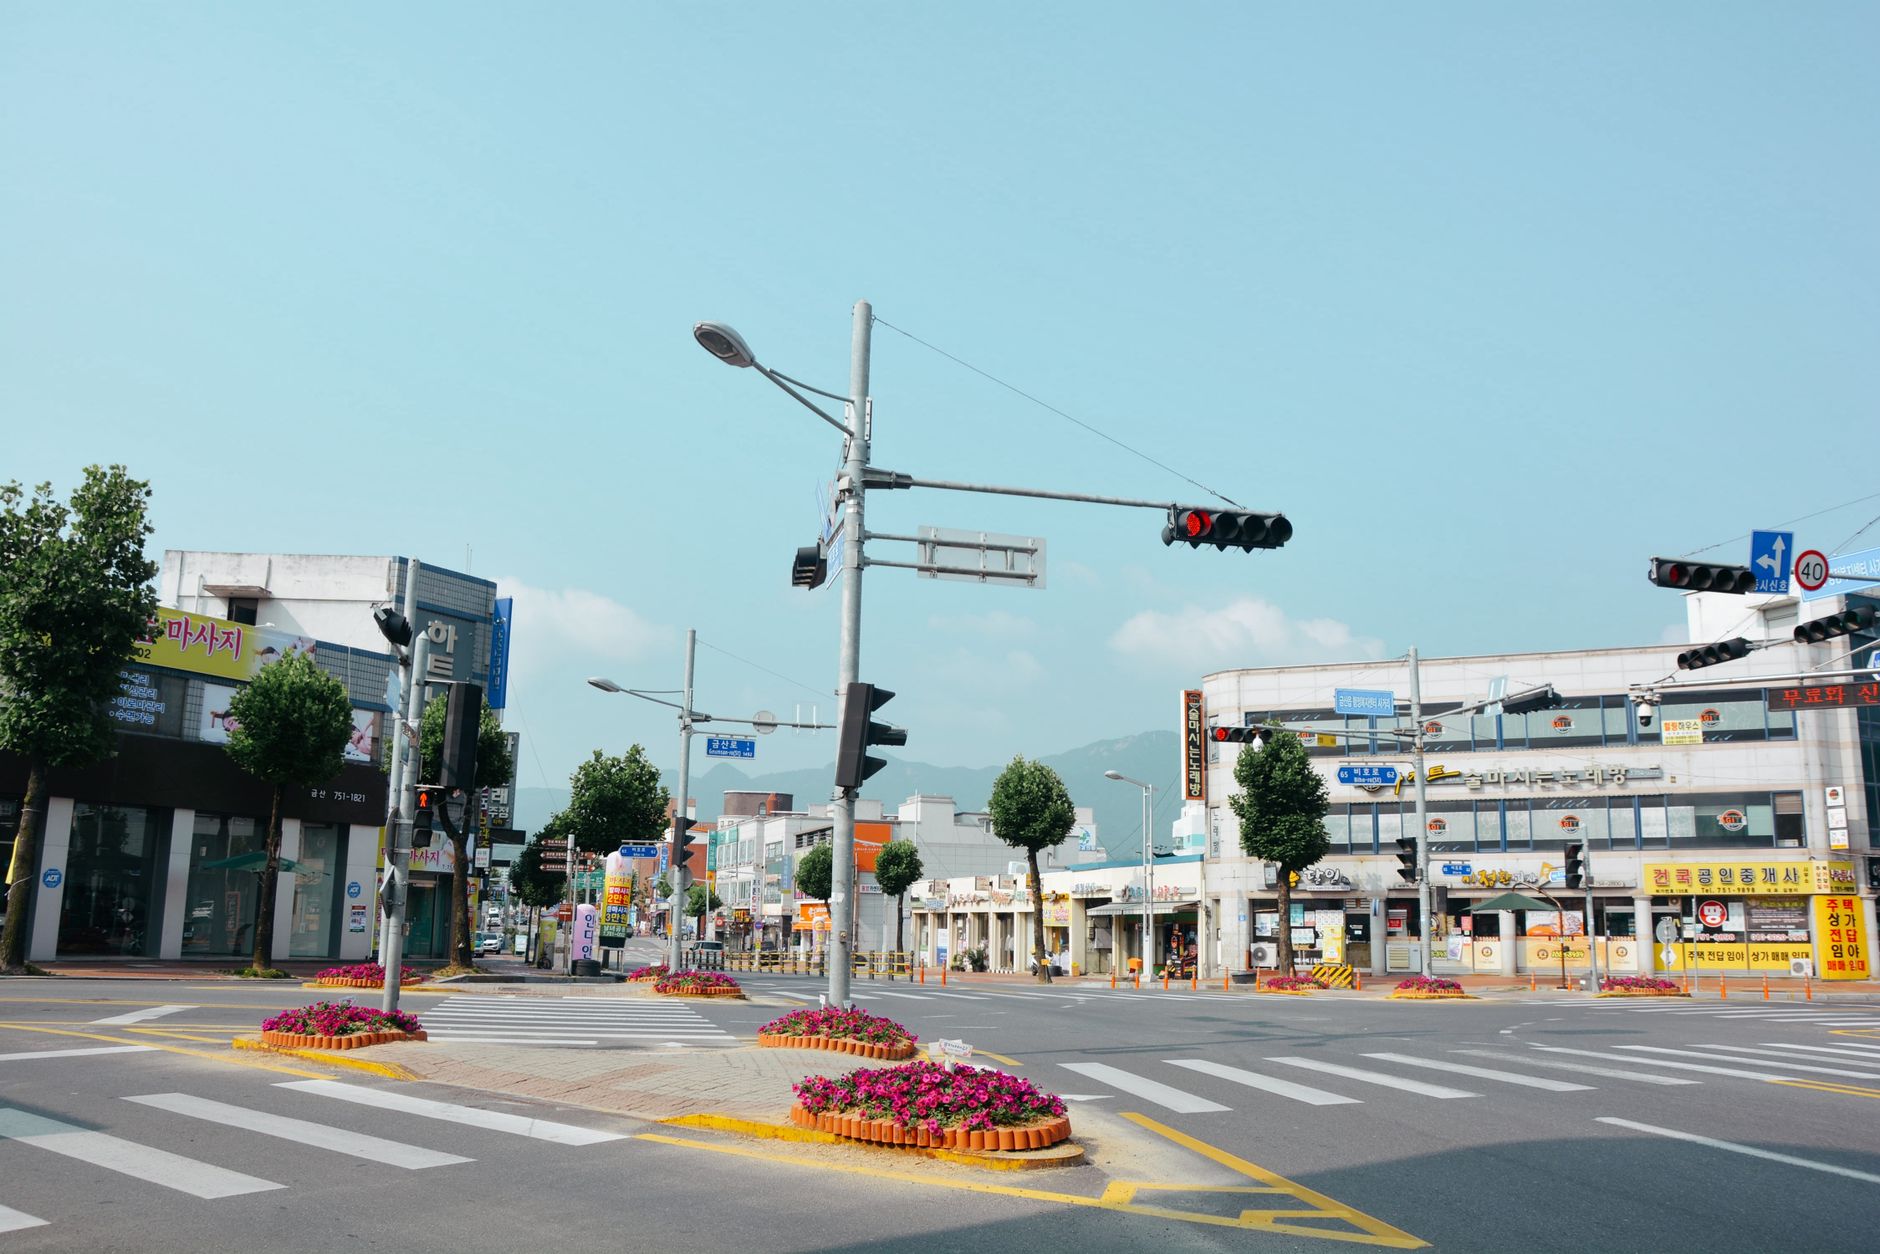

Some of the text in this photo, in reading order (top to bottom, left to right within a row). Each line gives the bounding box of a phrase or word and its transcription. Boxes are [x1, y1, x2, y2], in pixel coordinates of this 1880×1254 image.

[1801, 562, 1823, 581] 40
[167, 615, 243, 661] 마사지
[116, 697, 166, 714] 아로마관리
[712, 739, 738, 749] 금산로
[1353, 768, 1380, 776] 비호로
[311, 788, 366, 803] 금산 751-1821
[1826, 898, 1854, 913] 주택
[1828, 912, 1856, 928] 상가
[1830, 928, 1858, 943] 전답
[1707, 950, 1724, 962] 전답
[1726, 950, 1744, 962] 임야
[1751, 951, 1769, 962] 상가
[1831, 943, 1860, 959] 임야
[1827, 960, 1865, 971] 매매 임대
